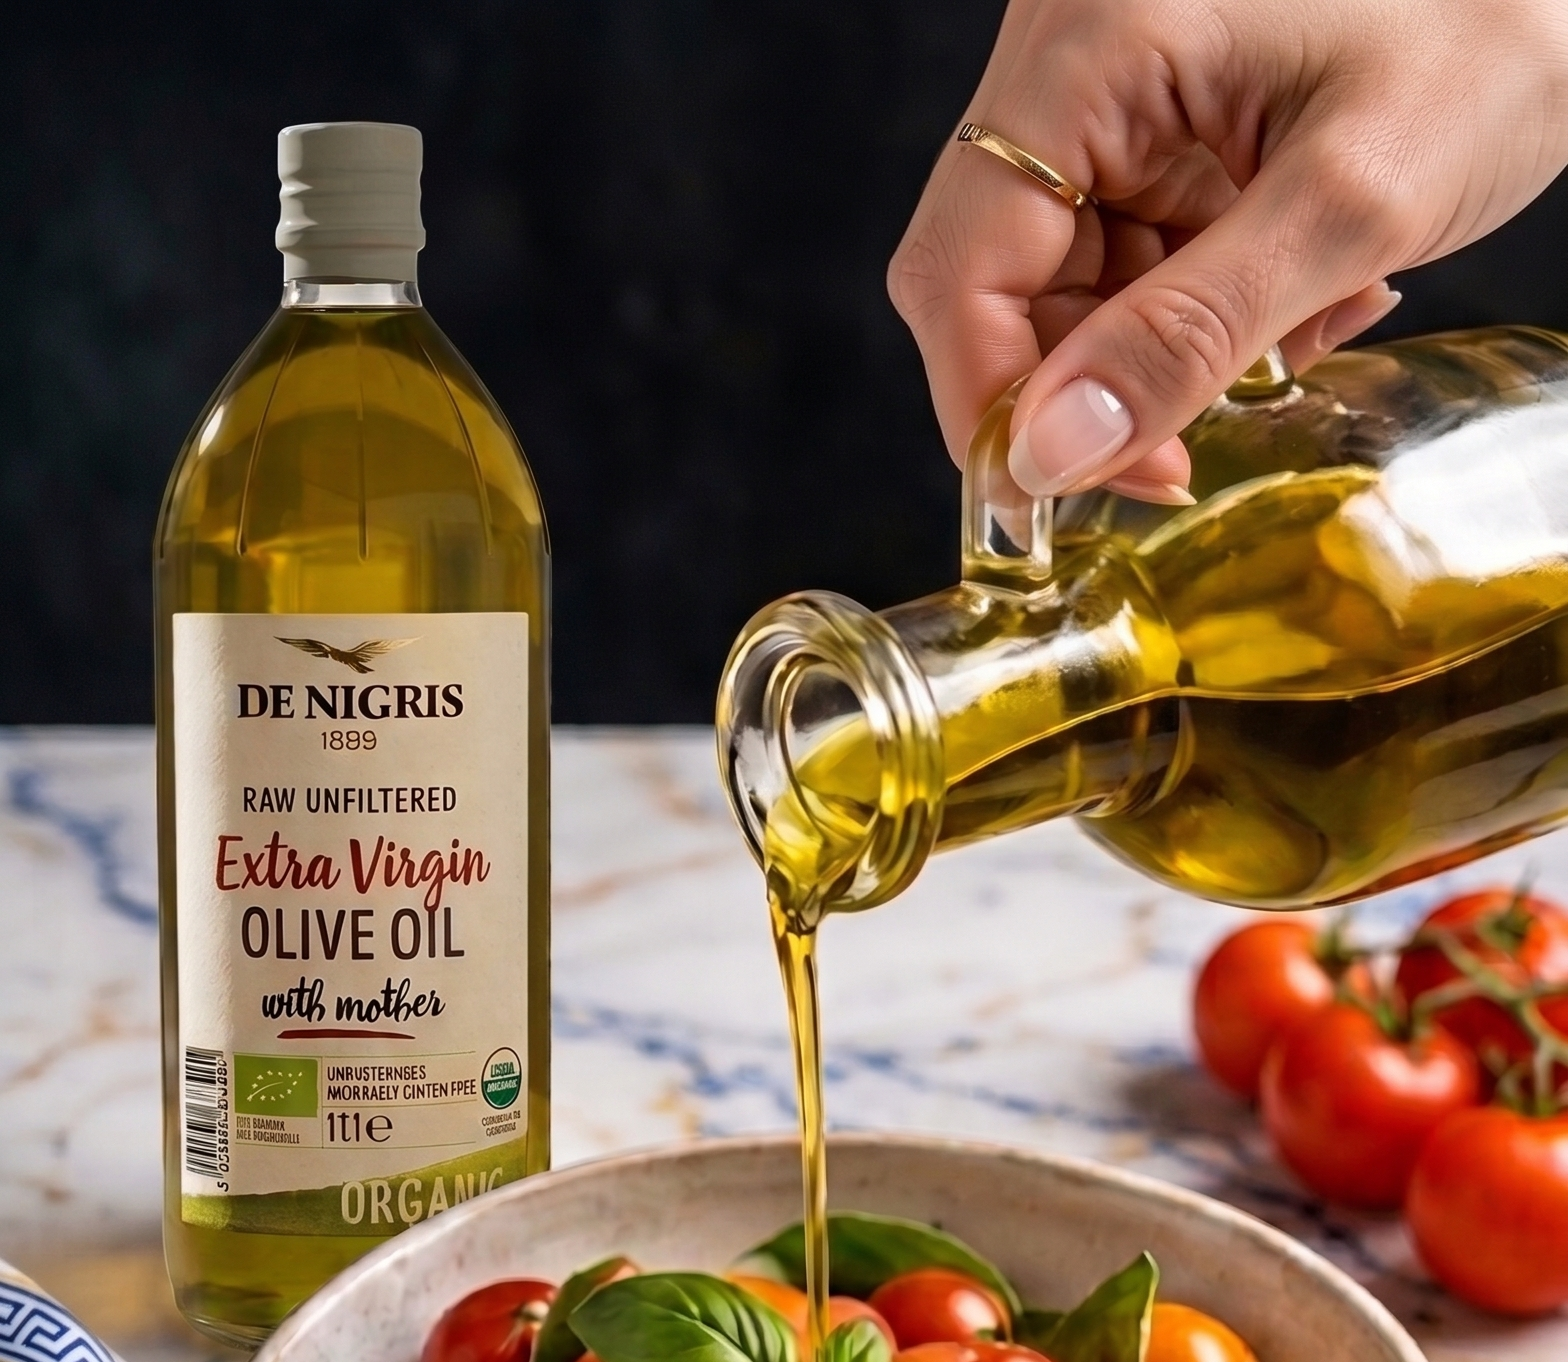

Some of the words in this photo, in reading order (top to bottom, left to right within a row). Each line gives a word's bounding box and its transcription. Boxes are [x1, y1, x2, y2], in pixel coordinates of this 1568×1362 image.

[237, 684, 295, 719] DE
[304, 684, 464, 719] NIGRIS
[243, 787, 296, 812] RAW
[306, 786, 457, 813] UNFILTERED
[215, 831, 341, 891] Extra
[349, 836, 491, 912] Virgin
[241, 906, 374, 960] OLIVE
[391, 906, 465, 960] OIL
[262, 976, 326, 1022] with
[335, 977, 446, 1022] mother
